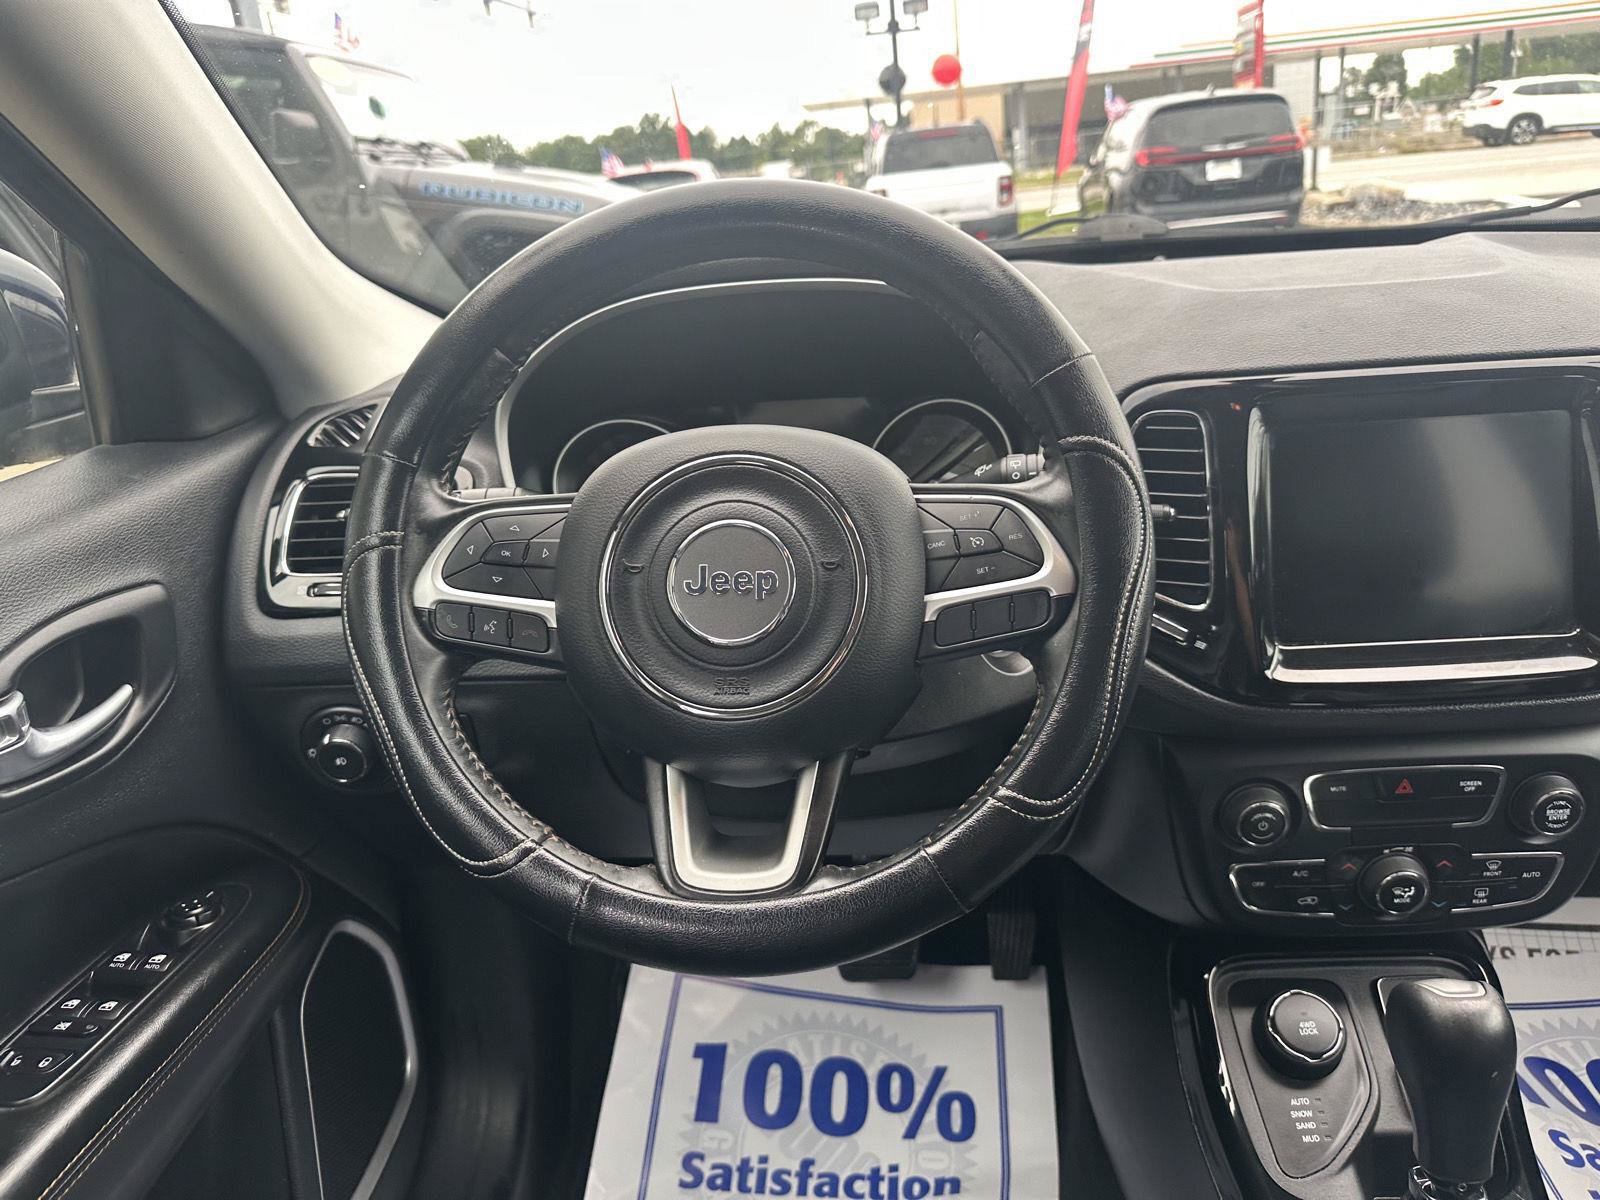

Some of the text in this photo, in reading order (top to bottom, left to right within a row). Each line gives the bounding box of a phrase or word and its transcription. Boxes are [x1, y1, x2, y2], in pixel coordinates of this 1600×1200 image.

[420, 179, 584, 213] RUBICON
[1008, 533, 1023, 541] RES
[927, 540, 945, 549] CANC
[683, 563, 779, 600] Jeep
[713, 677, 751, 687] SRS
[713, 687, 751, 696] AIRBAG
[1546, 808, 1571, 816] BROWSE
[1299, 1027, 1319, 1036] LOCK
[691, 1041, 977, 1143] 100%
[1290, 1097, 1310, 1105] AUTO
[1290, 1110, 1312, 1118] SNOW
[1295, 1121, 1316, 1130] SAND
[1302, 1134, 1320, 1143] MUD
[679, 1151, 962, 1200] Satisfaction
